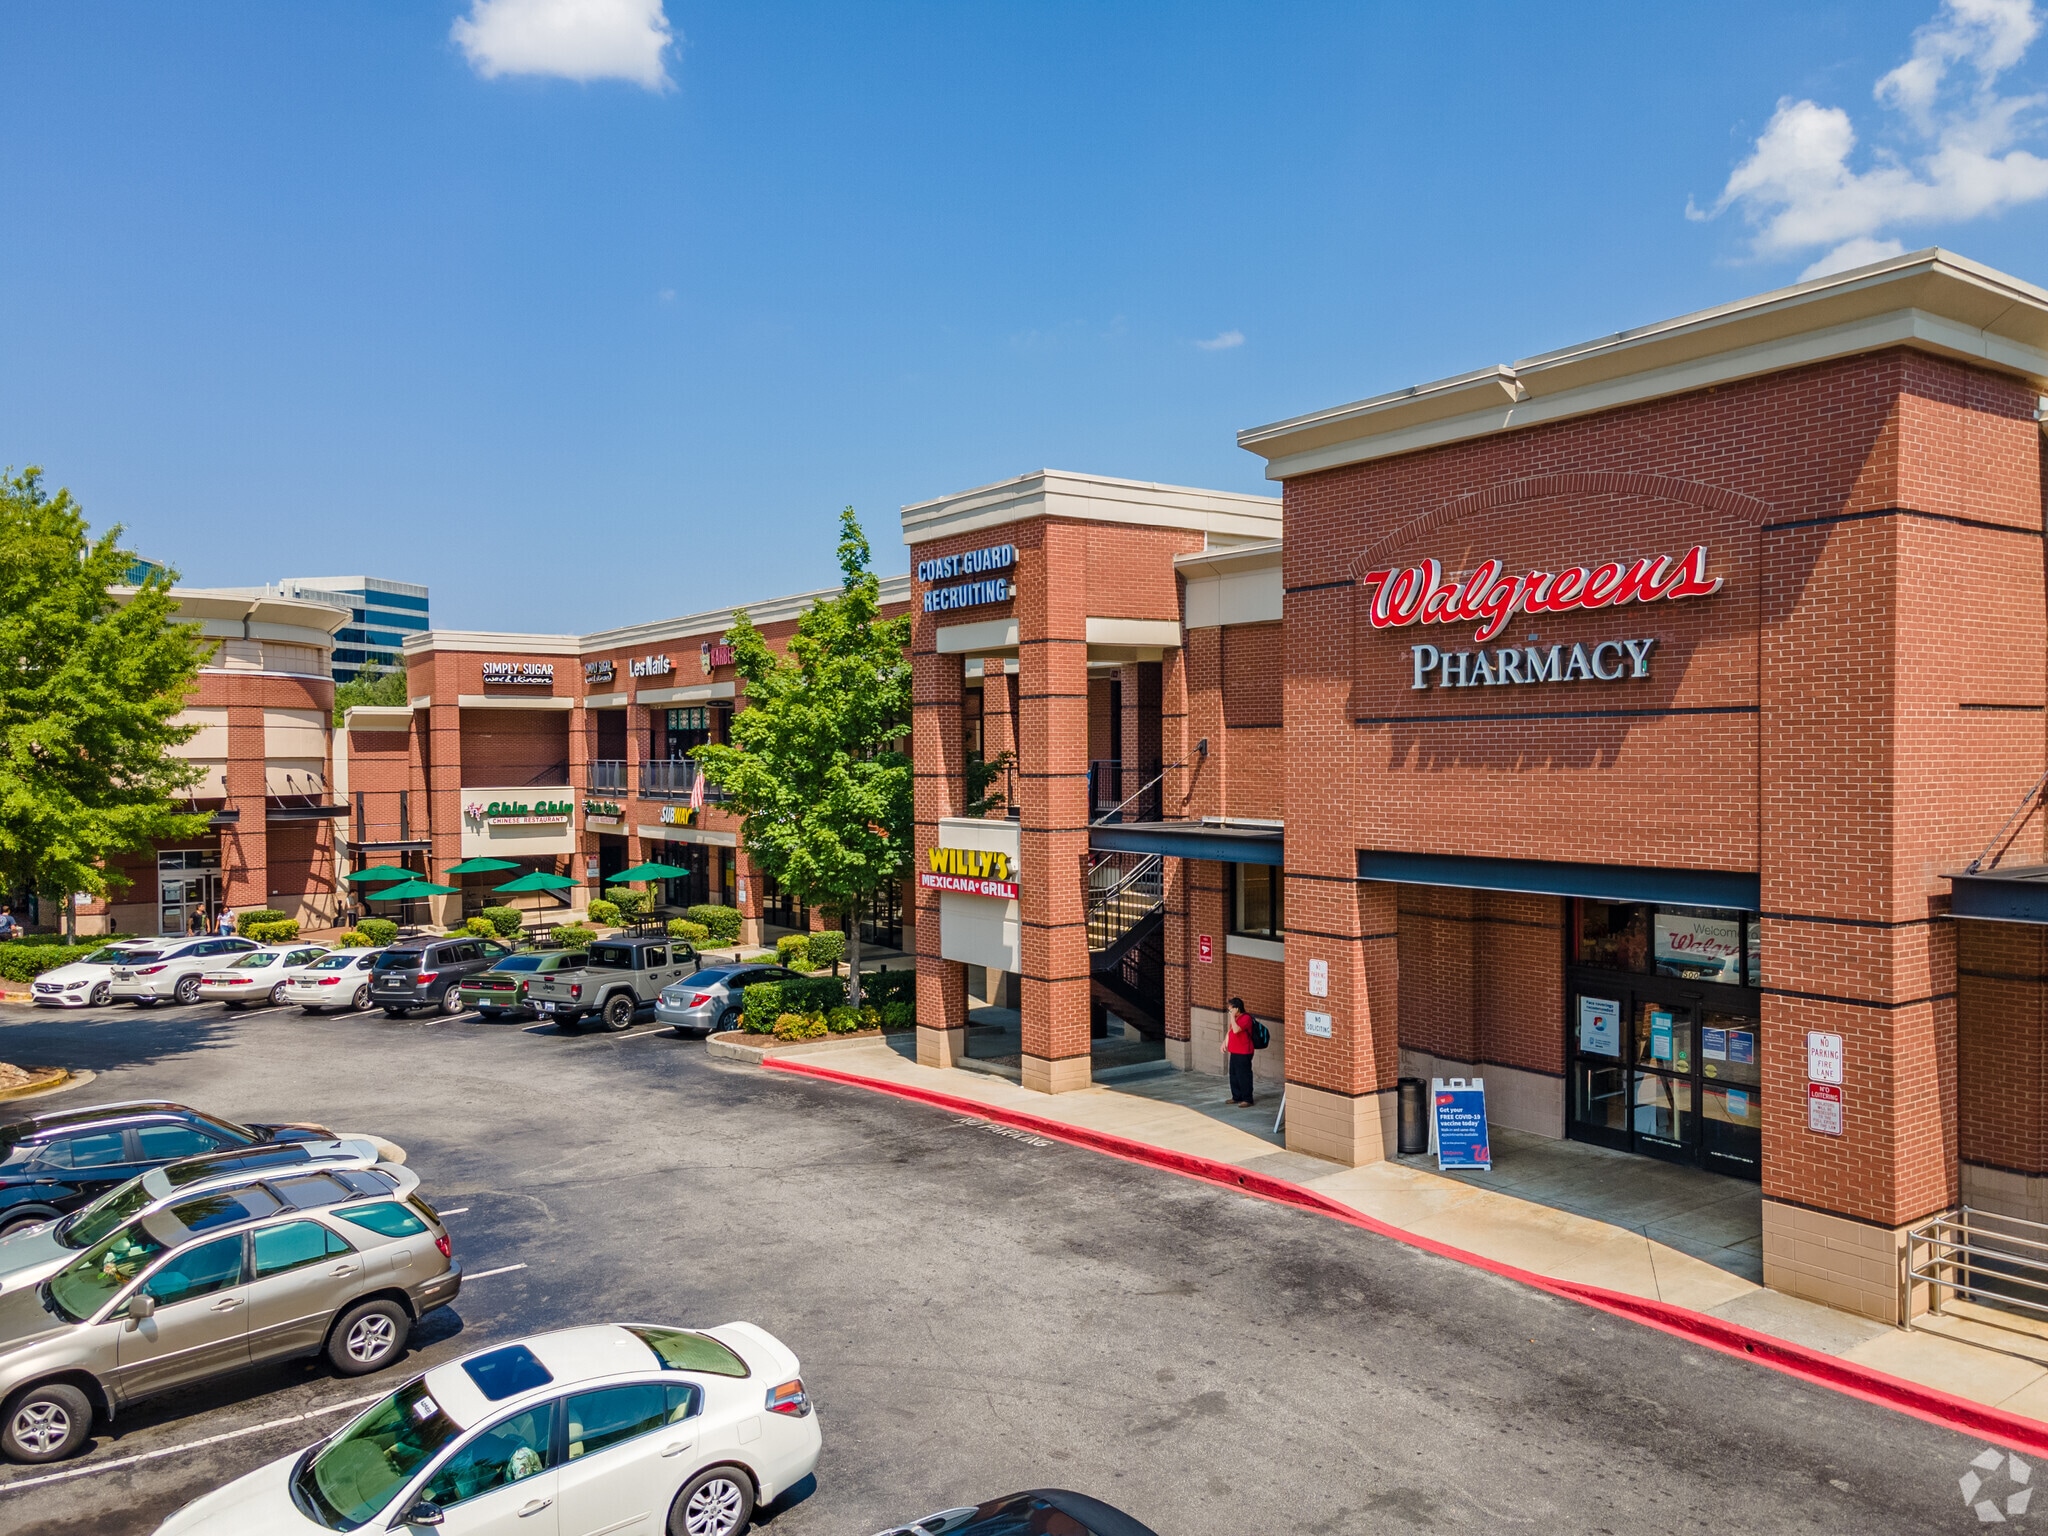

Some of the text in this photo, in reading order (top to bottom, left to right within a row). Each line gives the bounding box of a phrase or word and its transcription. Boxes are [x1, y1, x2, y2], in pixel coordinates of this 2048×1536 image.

[918, 544, 1015, 582] COAST GUARD
[924, 578, 1008, 612] RECRUITING
[1364, 545, 1724, 642] Walgreens
[483, 662, 554, 675] SIMPLY SUGAR
[1411, 638, 1655, 690] PHARMACY
[487, 801, 574, 816] Chin Chin
[660, 806, 693, 825] SUBWAY
[928, 847, 1009, 881] WILLY'S
[980, 881, 1016, 898] GRILL
[1693, 923, 1740, 938] Welcom
[1307, 1023, 1330, 1033] SOLICITING
[1820, 1038, 1829, 1047] NO
[1811, 1048, 1839, 1060] PARKING
[1817, 1060, 1832, 1068] FIRE
[1816, 1067, 1834, 1078] LANE
[1811, 1090, 1839, 1101] LOITERING
